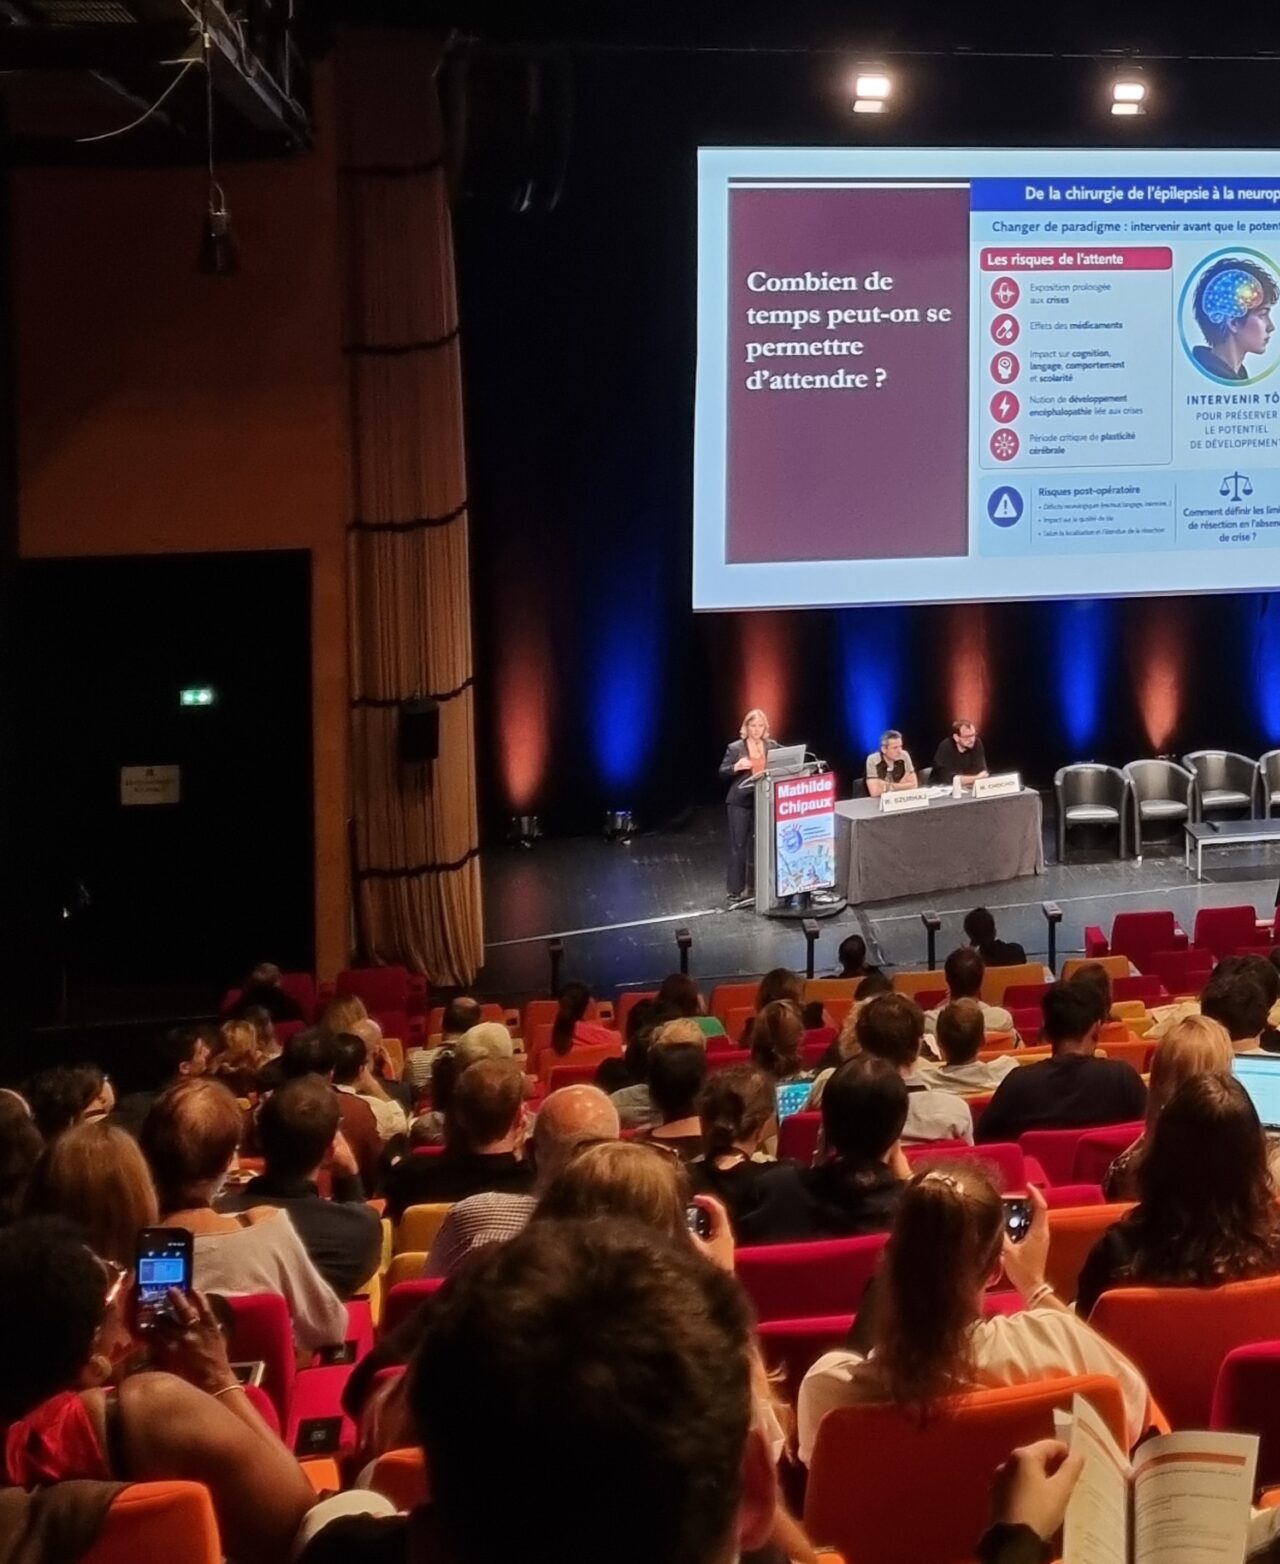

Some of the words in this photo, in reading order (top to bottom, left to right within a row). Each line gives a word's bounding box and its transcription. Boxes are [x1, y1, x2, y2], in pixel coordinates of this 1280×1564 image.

[1026, 186, 1044, 200] De
[1049, 186, 1060, 200] la
[1066, 186, 1124, 203] chirurgie
[1128, 186, 1144, 200] de
[1148, 185, 1209, 203] l'épilepsie
[1213, 185, 1220, 199] à
[1224, 185, 1234, 200] la
[992, 221, 1039, 235] Changer
[1044, 221, 1057, 232] de
[1062, 221, 1120, 235] paradigme
[1131, 221, 1179, 231] intervenir
[1183, 221, 1211, 231] avant
[1215, 222, 1233, 234] que
[1237, 221, 1246, 230] le
[988, 253, 1007, 265] Les
[1012, 254, 1054, 269] risques
[1059, 254, 1073, 265] de
[1077, 253, 1123, 265] l'attente
[747, 271, 857, 292] Combien
[864, 271, 893, 291] de
[1030, 283, 1070, 294] Exposition
[1046, 296, 1069, 304] crises
[747, 307, 820, 329] temps
[827, 307, 919, 329] peut-on
[927, 307, 952, 322] se
[1030, 321, 1051, 330] Effets
[1054, 321, 1068, 330] des
[1070, 320, 1123, 330] médicaments
[746, 339, 863, 362] permettre
[1066, 361, 1125, 371] comportement
[875, 368, 887, 388] ?
[1040, 374, 1073, 382] scolarité
[1069, 395, 1127, 405] développement
[1187, 394, 1260, 405] INTERVENIR
[1196, 411, 1222, 420] POUR
[1226, 410, 1277, 419] PRÉSERVER
[1205, 426, 1215, 434] LE
[1219, 425, 1268, 434] POTENTIEL
[1191, 440, 1201, 449] DE
[1039, 488, 1071, 496] Risques
[1074, 485, 1140, 496] post-opératoire
[1183, 507, 1222, 517] Comment
[1225, 506, 1251, 516] définir
[1253, 505, 1264, 515] les
[1188, 521, 1198, 530] de
[1201, 520, 1237, 529] résection
[1219, 533, 1229, 542] de
[1232, 533, 1250, 541] crise
[778, 779, 833, 798] Mathilde
[779, 797, 831, 815] Chipaux
